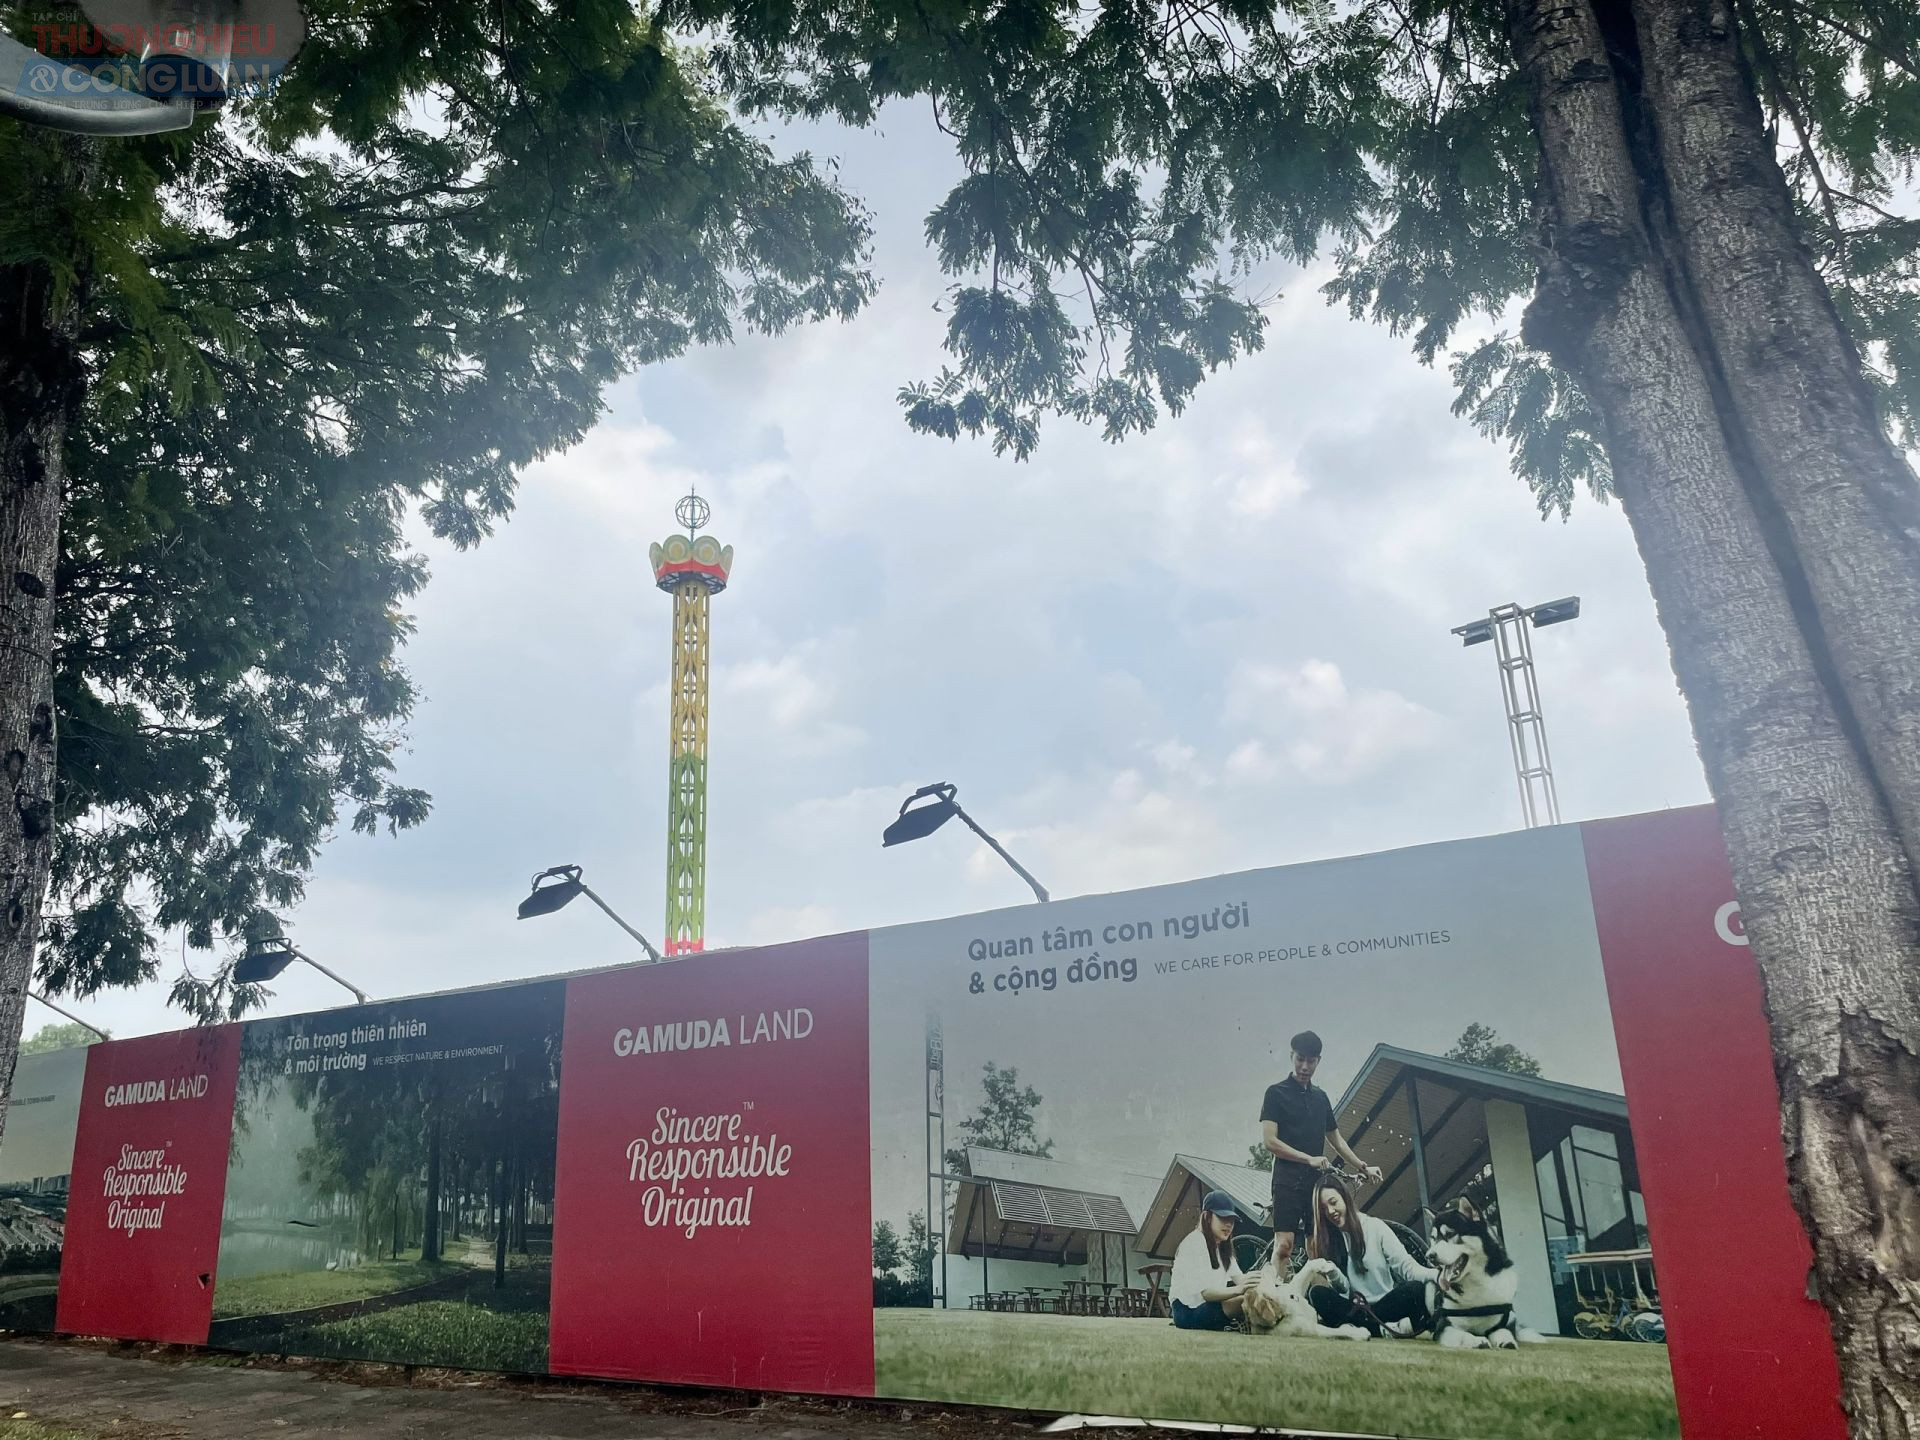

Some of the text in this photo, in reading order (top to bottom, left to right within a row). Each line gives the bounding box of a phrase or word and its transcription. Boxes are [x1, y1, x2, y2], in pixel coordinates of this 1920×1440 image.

[968, 901, 1250, 961] Quan tâm con người
[1154, 930, 1451, 974] WE CARE FOR PEOPLE & COMMUNITIES
[968, 951, 1138, 996] & cộng đồng
[287, 1019, 427, 1052] Tôn trọng thiên nhiên
[613, 1007, 814, 1057] GAMUDA LAND
[284, 1052, 367, 1075] & môi trường
[372, 1056, 384, 1066] WE
[385, 1053, 414, 1065] RESPECT
[415, 1050, 443, 1062] NATURE
[451, 1044, 504, 1059] ENVIRONMENT
[104, 1074, 209, 1108] GAMUDA LAND
[651, 1106, 742, 1145] Sincere
[117, 1143, 165, 1171] Sincere
[626, 1134, 792, 1193] Responsible
[103, 1164, 188, 1204] Responsible
[107, 1201, 165, 1238] Original
[641, 1185, 754, 1240] Original
